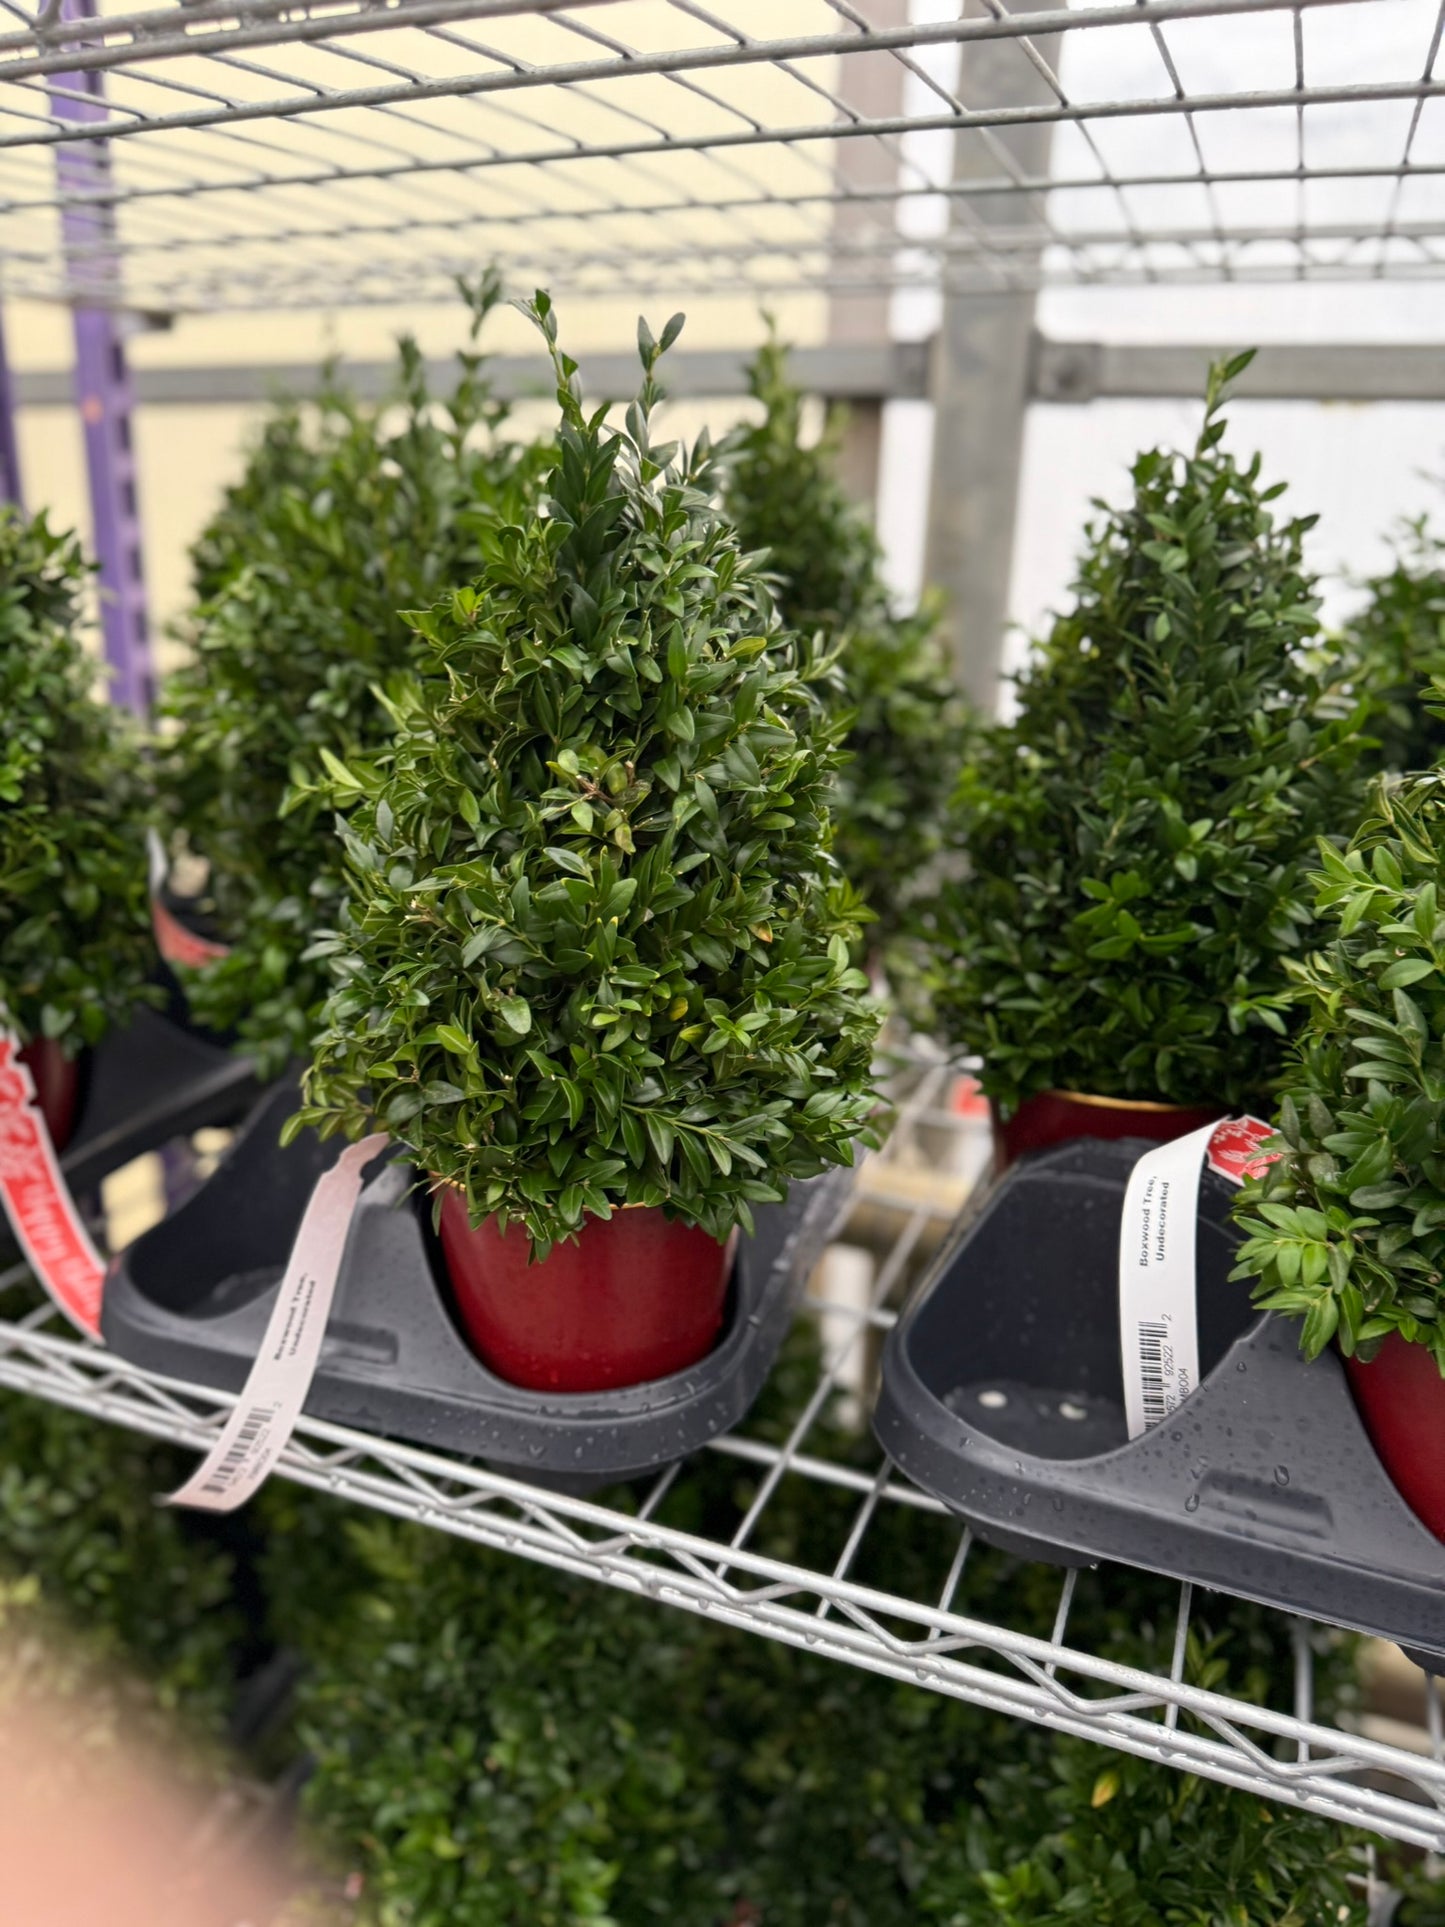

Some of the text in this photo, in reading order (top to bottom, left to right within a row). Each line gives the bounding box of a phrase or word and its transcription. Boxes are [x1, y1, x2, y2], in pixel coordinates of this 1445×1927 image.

[1139, 1176, 1158, 1267] Boxwood Tree,
[1156, 1181, 1170, 1261] Undecorated
[1161, 1313, 1172, 1321] 2
[1162, 1345, 1174, 1376] 92522
